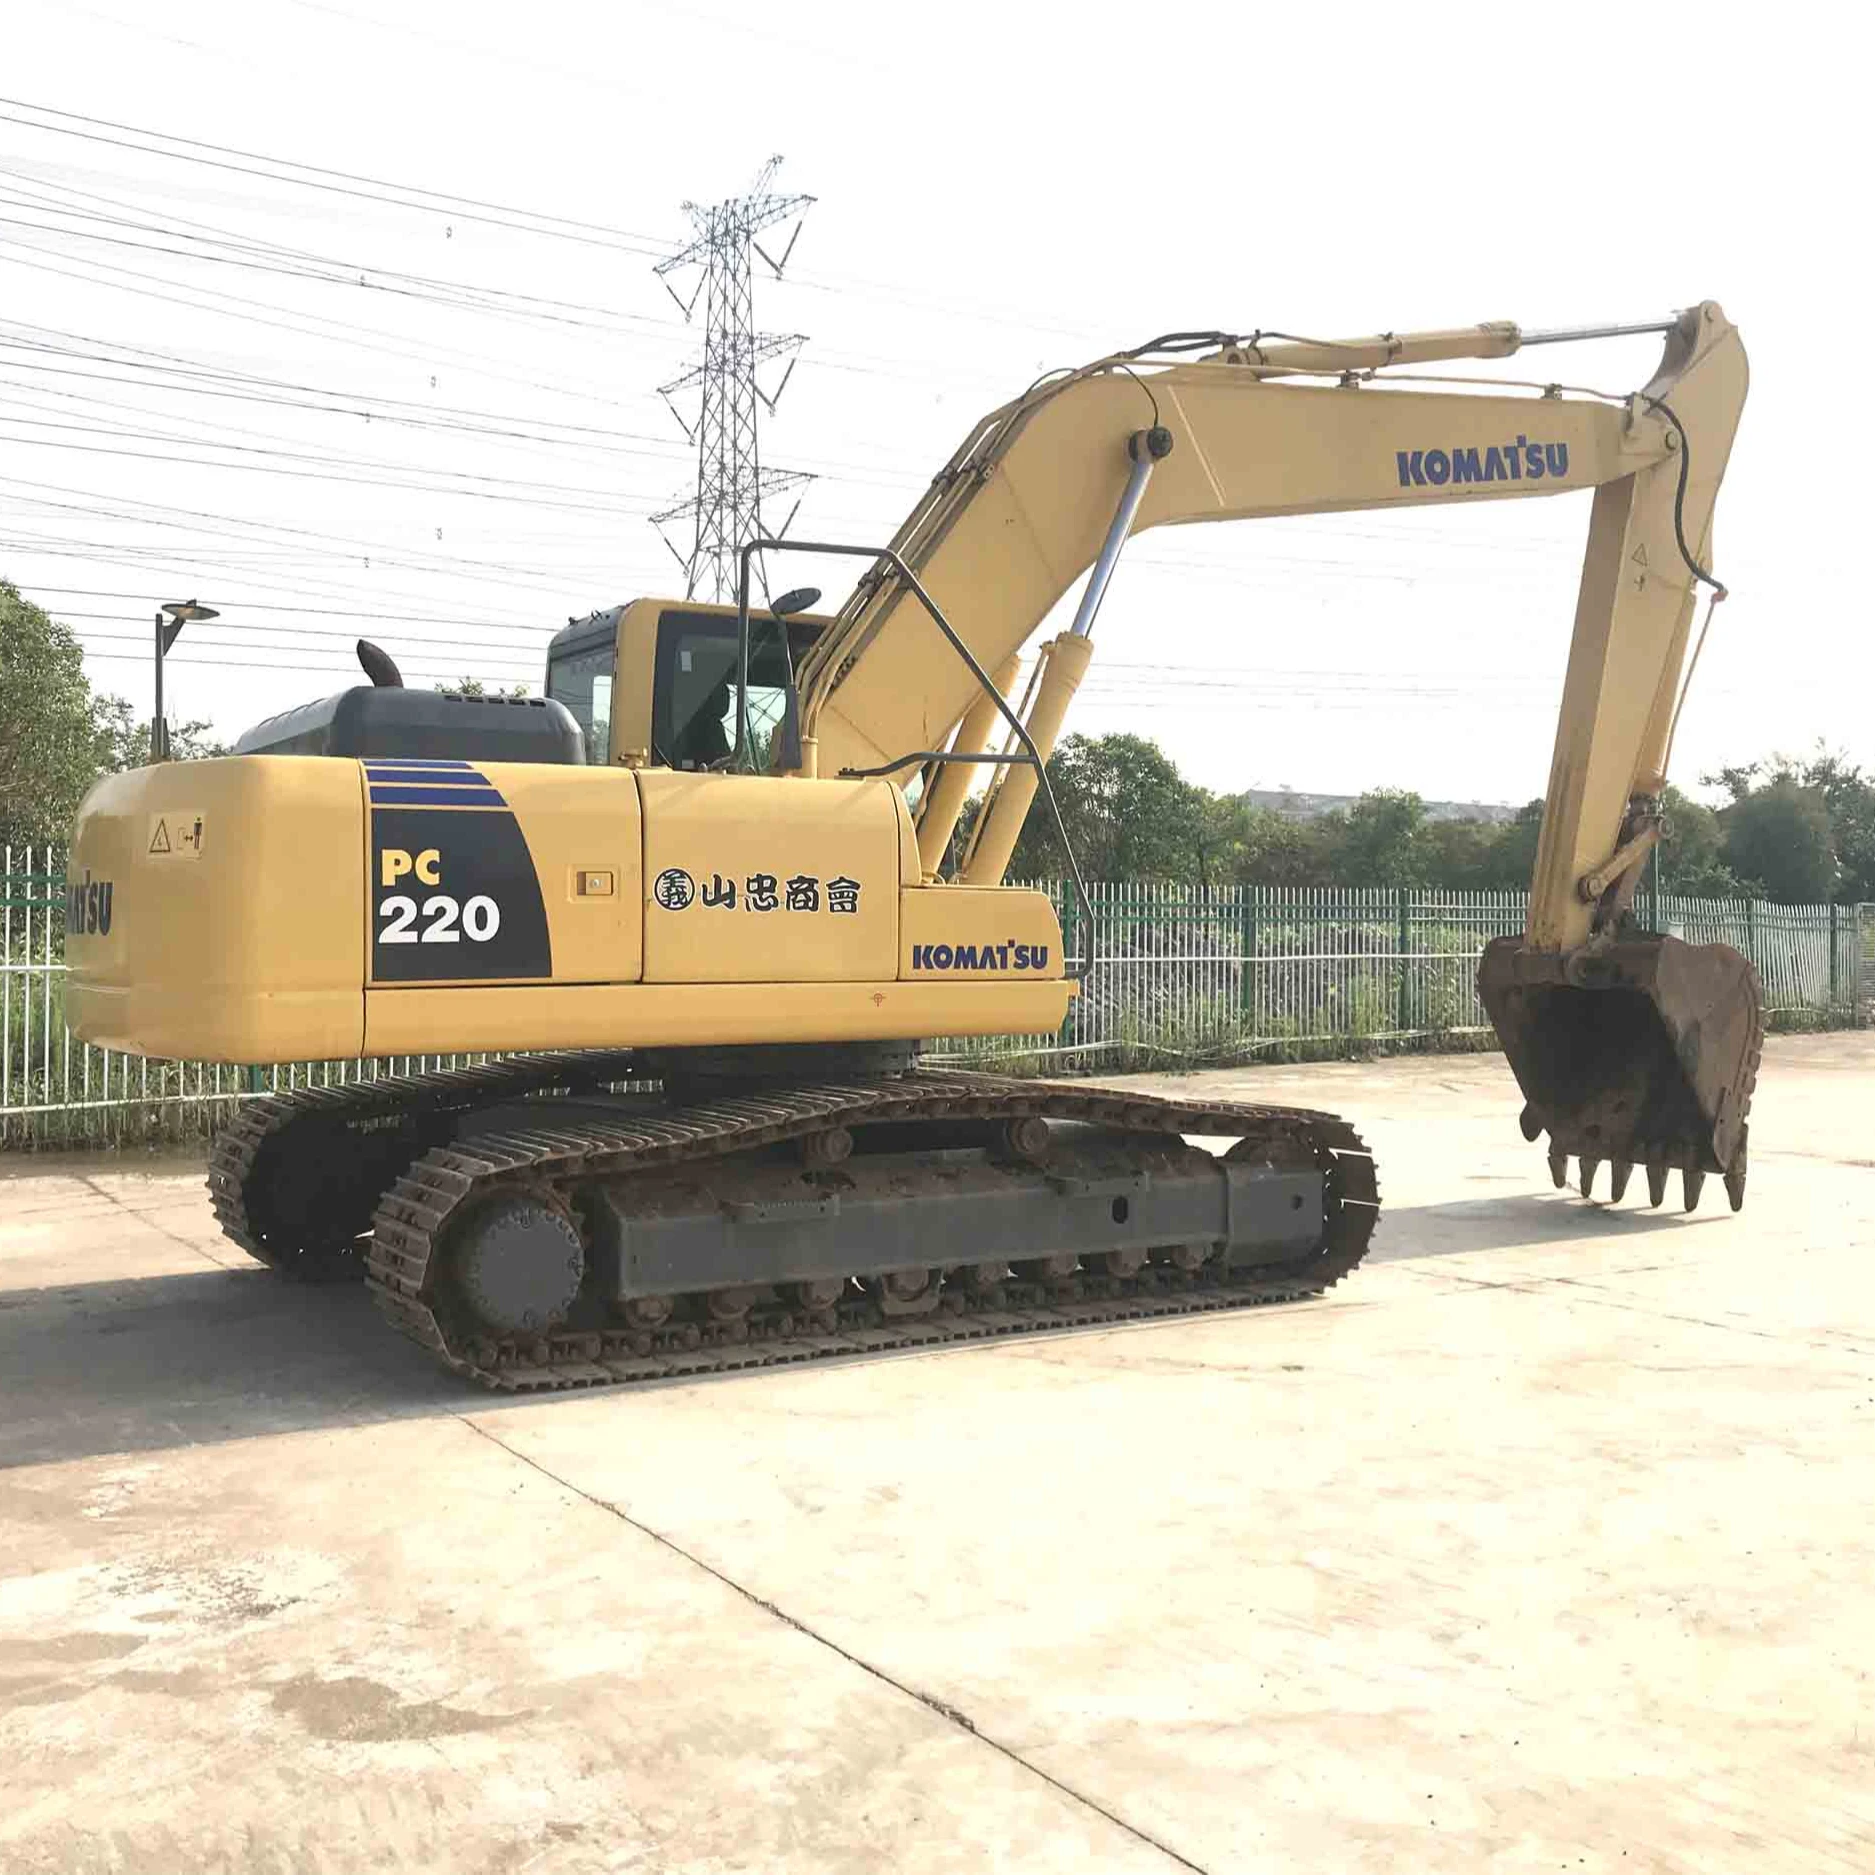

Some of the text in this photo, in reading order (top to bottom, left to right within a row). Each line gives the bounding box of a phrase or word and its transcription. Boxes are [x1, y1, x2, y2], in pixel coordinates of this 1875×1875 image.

[1396, 434, 1568, 487] KOMATSU
[381, 848, 440, 887] PC
[378, 895, 500, 944] 220
[912, 939, 1048, 970] KOMATSU
